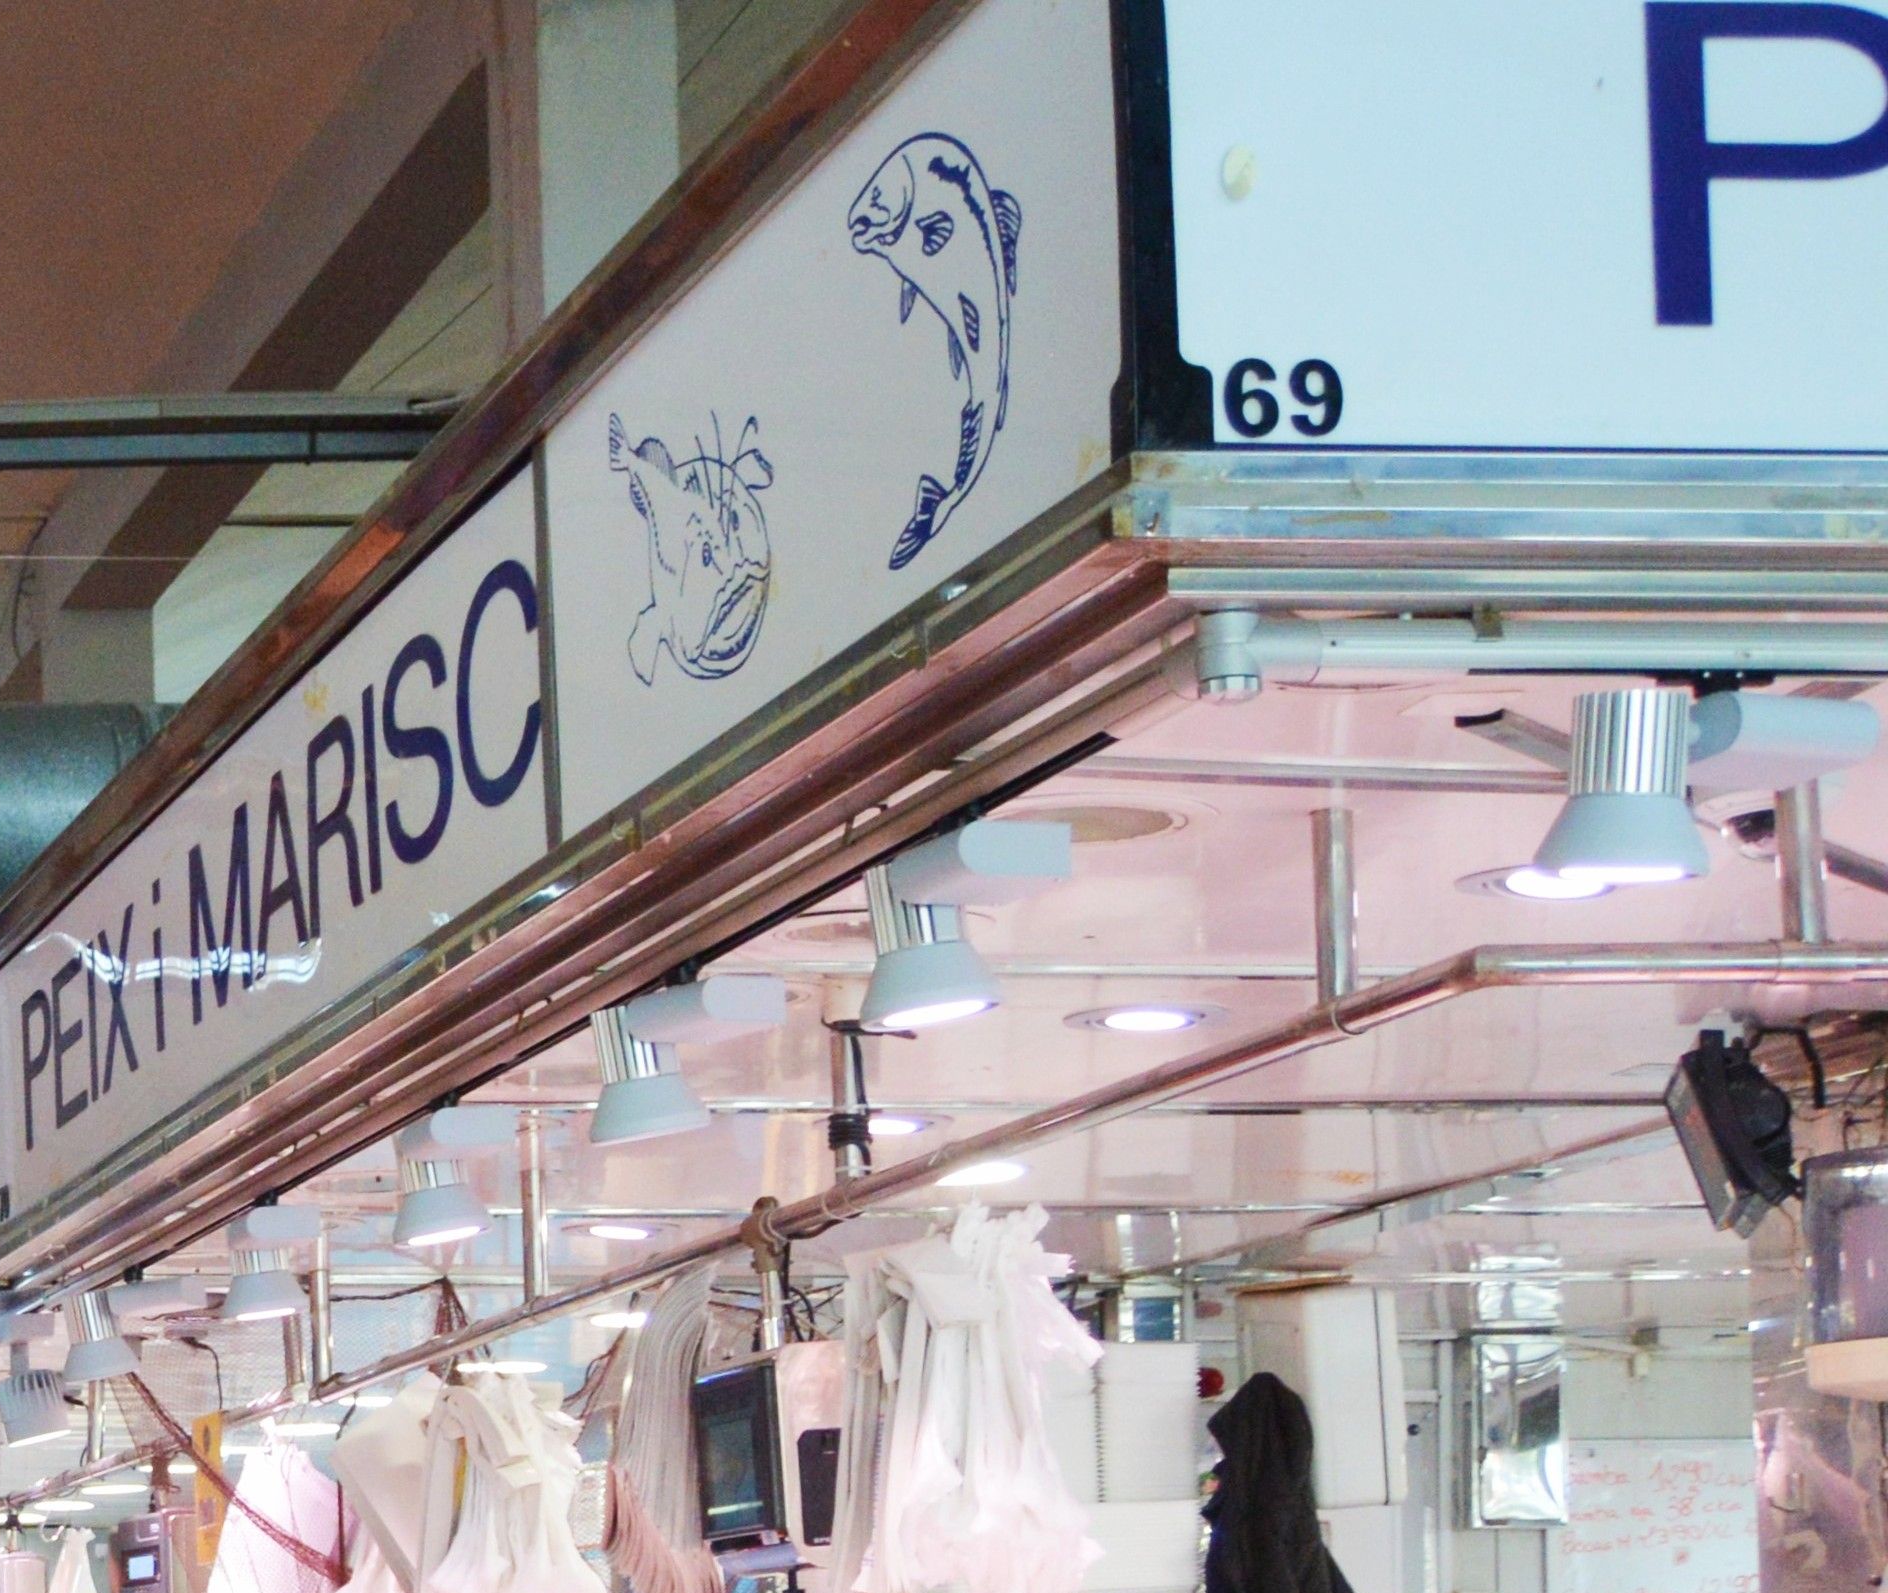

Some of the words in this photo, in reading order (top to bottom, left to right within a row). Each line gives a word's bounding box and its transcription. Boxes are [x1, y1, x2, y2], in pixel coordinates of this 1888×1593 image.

[1224, 357, 1343, 439] 69
[22, 904, 138, 1150] PEIX
[152, 879, 165, 1052] i
[188, 559, 543, 1026] MARISC
